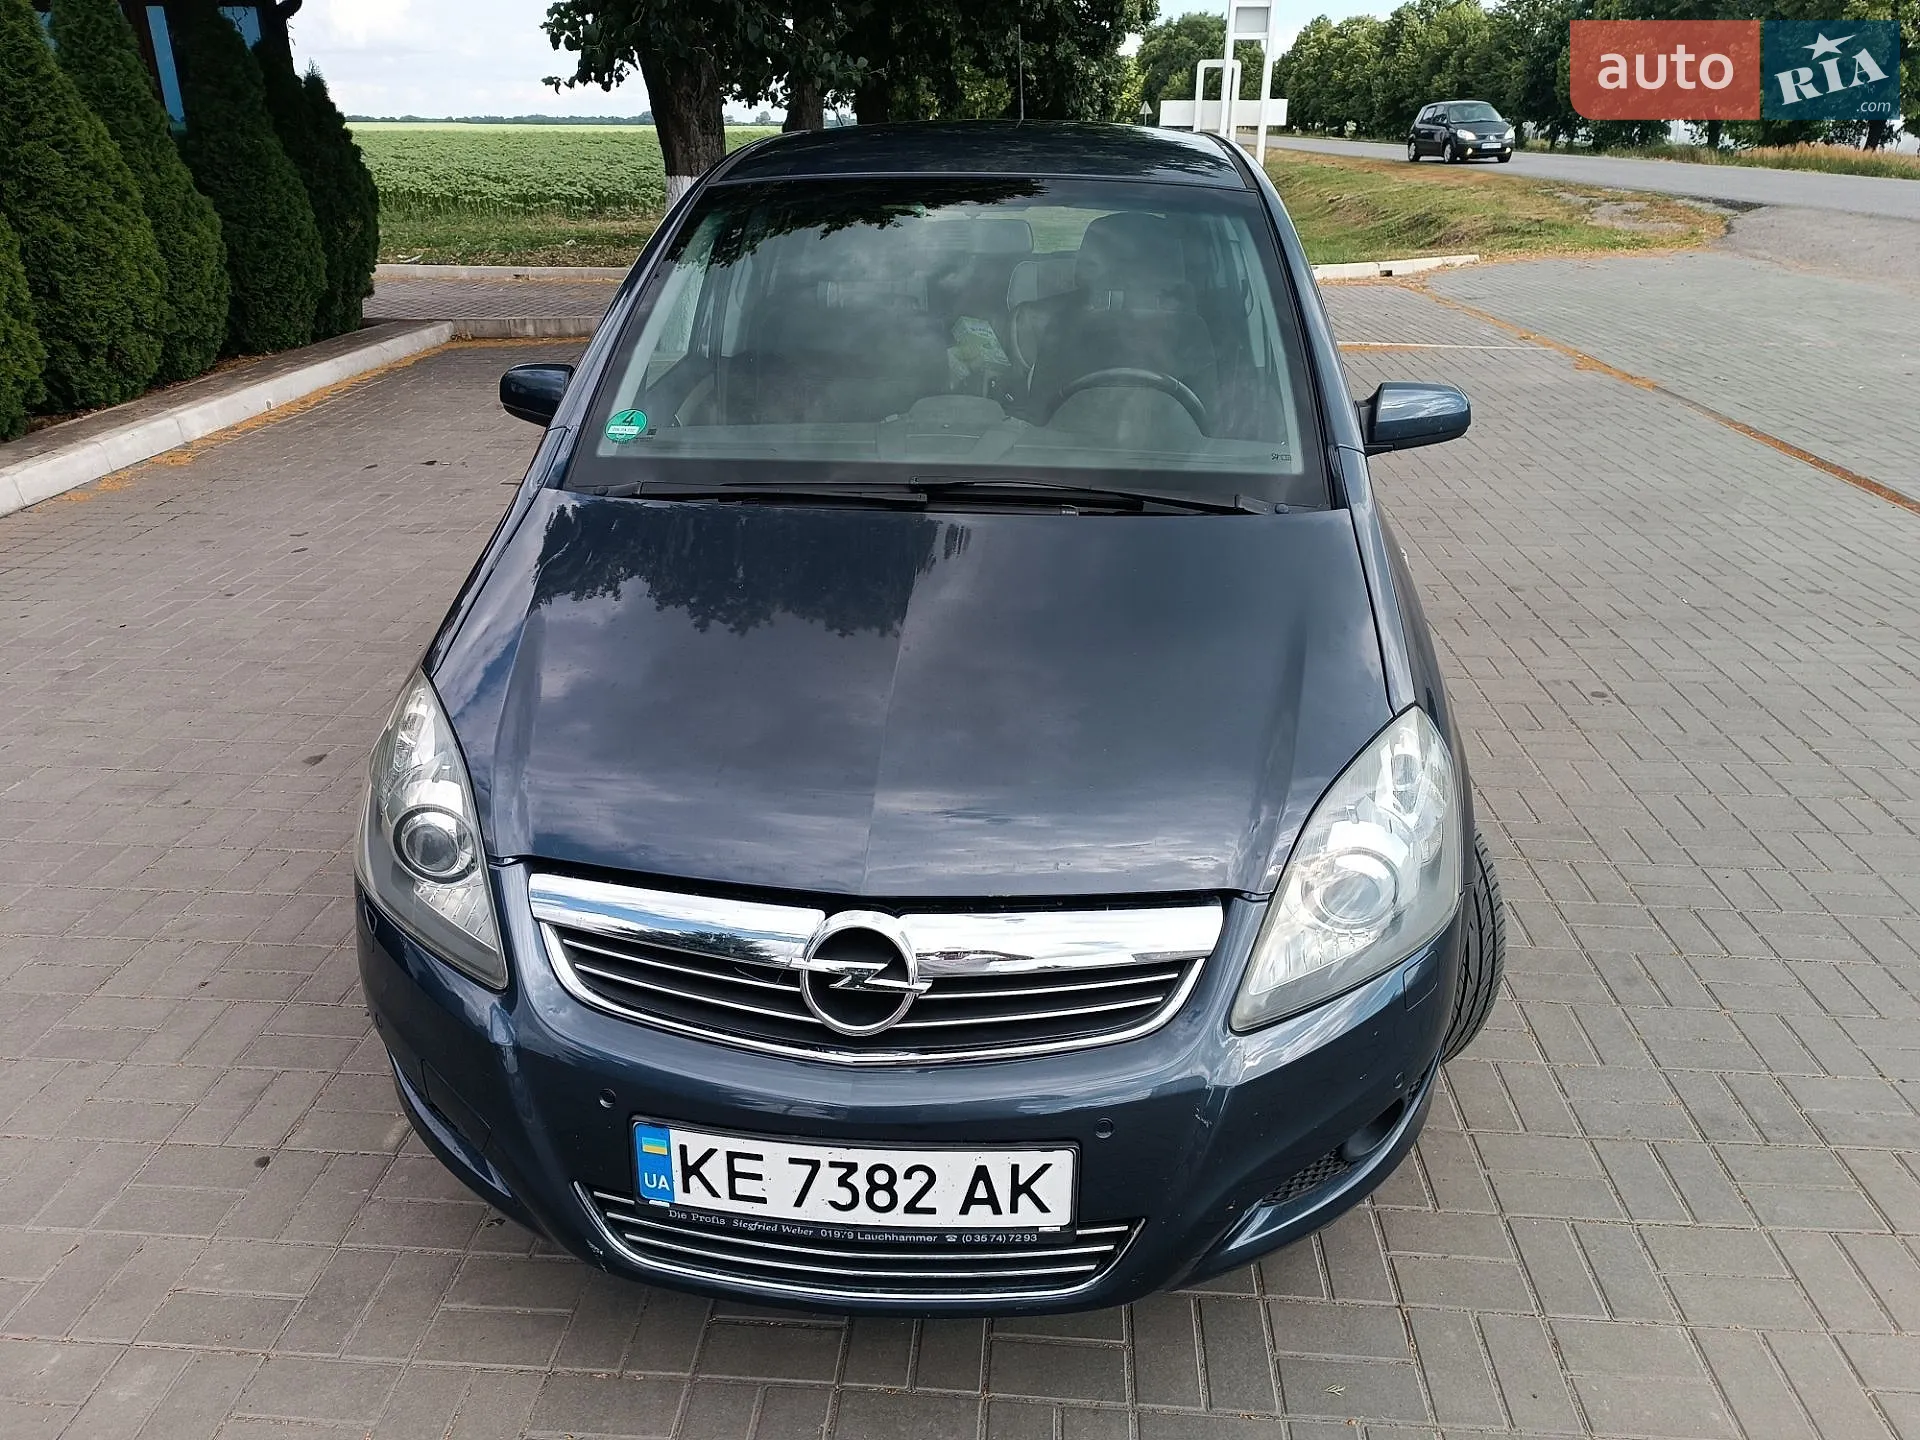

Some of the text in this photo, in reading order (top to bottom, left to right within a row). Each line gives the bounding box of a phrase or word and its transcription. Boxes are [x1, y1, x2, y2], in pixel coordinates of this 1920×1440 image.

[622, 410, 637, 426] 4
[644, 1172, 671, 1191] UA
[679, 1143, 1053, 1215] KE 7382 AK
[668, 1209, 687, 1219] Die
[691, 1213, 726, 1225] Profis
[857, 1231, 938, 1243] Lauchhammer
